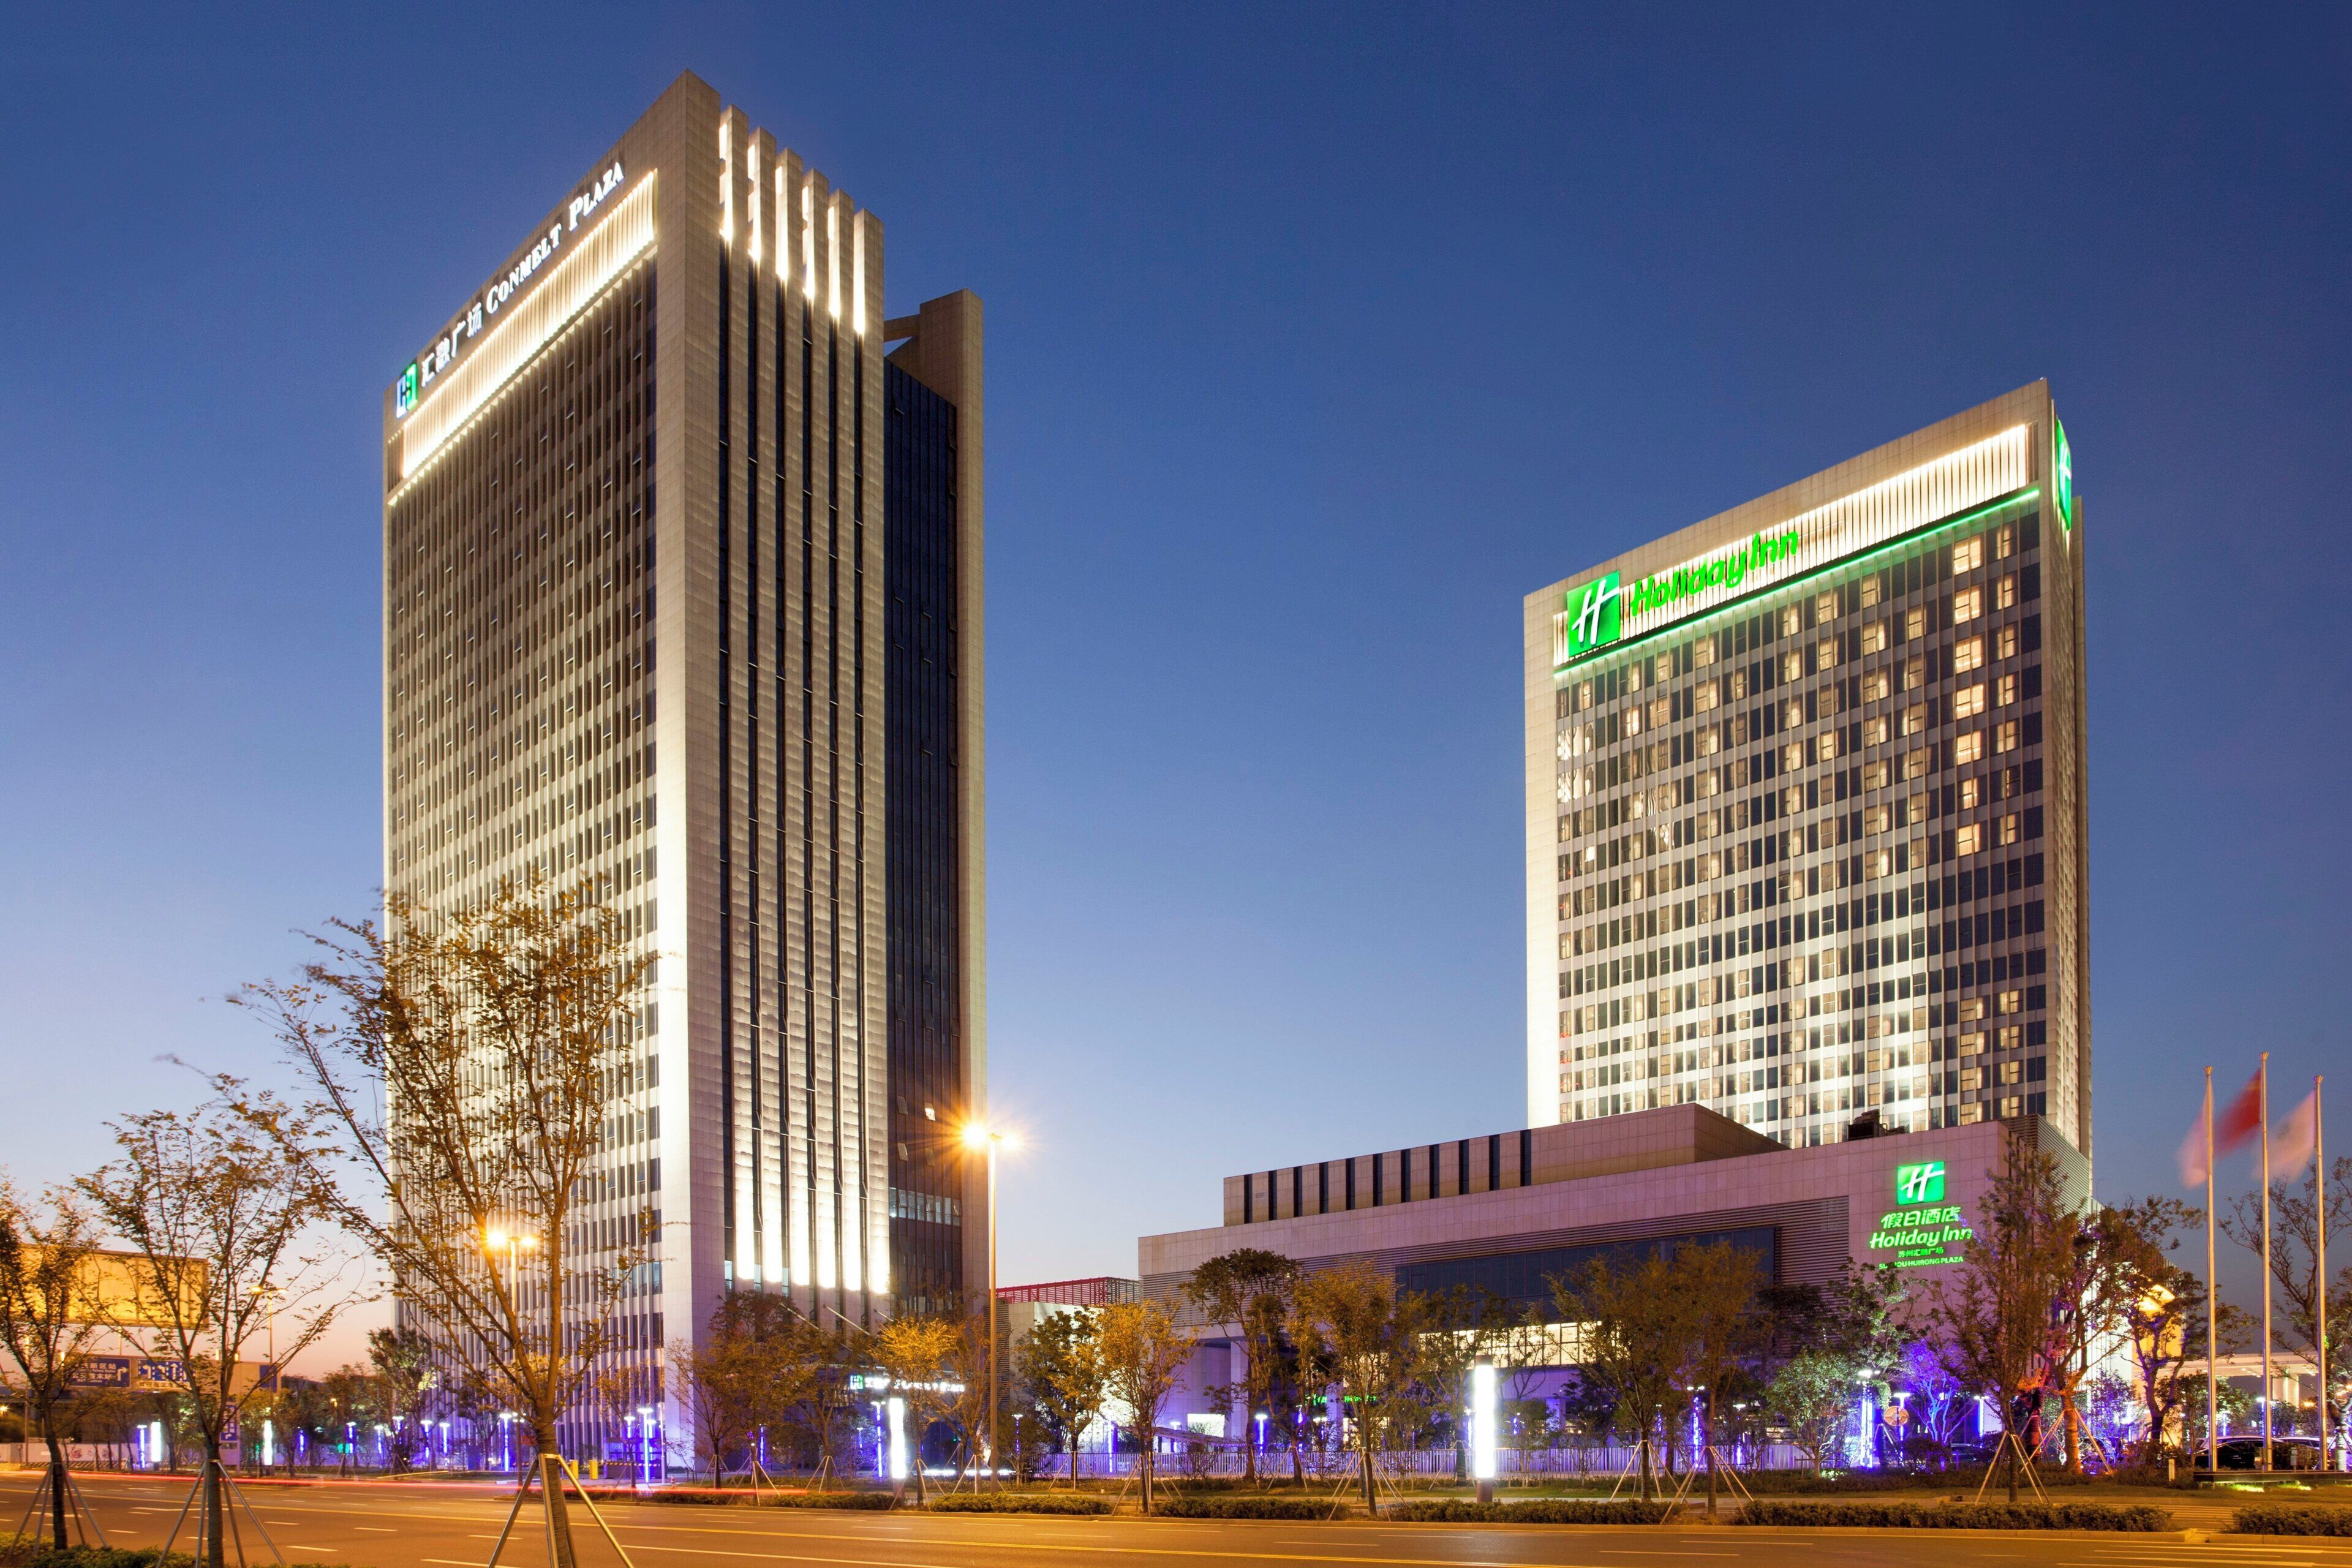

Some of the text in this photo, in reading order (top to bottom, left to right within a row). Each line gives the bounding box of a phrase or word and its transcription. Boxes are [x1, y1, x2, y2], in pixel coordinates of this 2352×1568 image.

[421, 162, 624, 387] 汇融广场 CONMELT PLAZA
[1630, 531, 1798, 617] Holiday Inn
[1881, 1206, 1961, 1229] 假日酒店
[1869, 1225, 1972, 1249] Holiday Inn
[1908, 1258, 1940, 1267] HUIRONG
